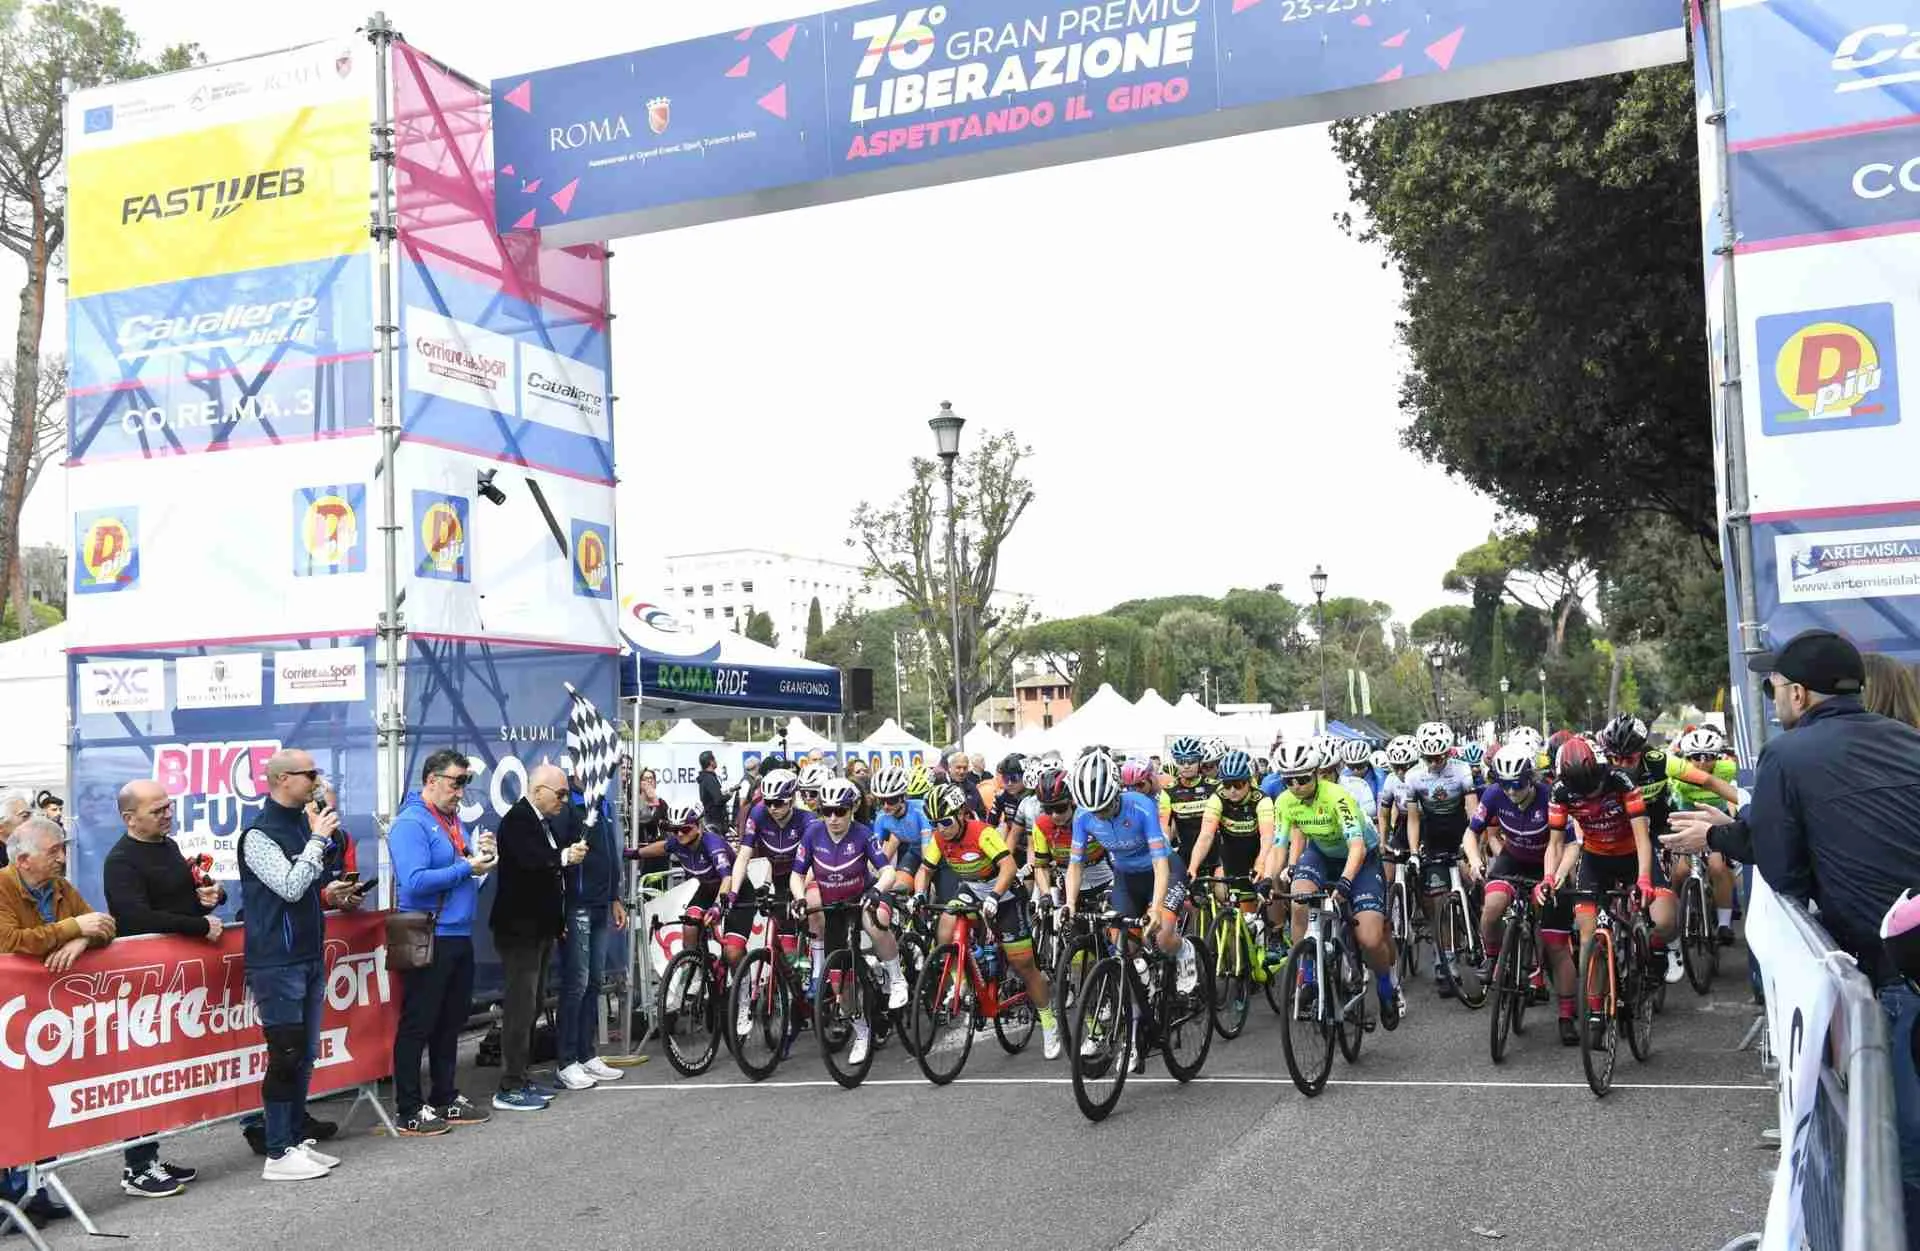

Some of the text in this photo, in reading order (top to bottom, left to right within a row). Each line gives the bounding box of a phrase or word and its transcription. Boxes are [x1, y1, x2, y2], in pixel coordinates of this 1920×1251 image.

[853, 0, 1200, 78] 76° GRAN PREMIO
[850, 20, 1197, 122] LIBERAZIONE
[550, 115, 631, 151] ROMA
[846, 77, 1189, 160] ASPETTANDO IL GIRO
[122, 167, 305, 225] FASTWEB
[122, 389, 314, 435] CO.RE.MA.3
[527, 371, 602, 406] Cavaliere
[1820, 542, 1912, 560] ARTEMISIA
[778, 679, 832, 696] GRANFONDO
[501, 726, 556, 741] SALUMI
[158, 746, 277, 796] BIKE
[0, 981, 208, 1070] Corriere
[71, 1056, 241, 1115] SEMPLICEMENTE
